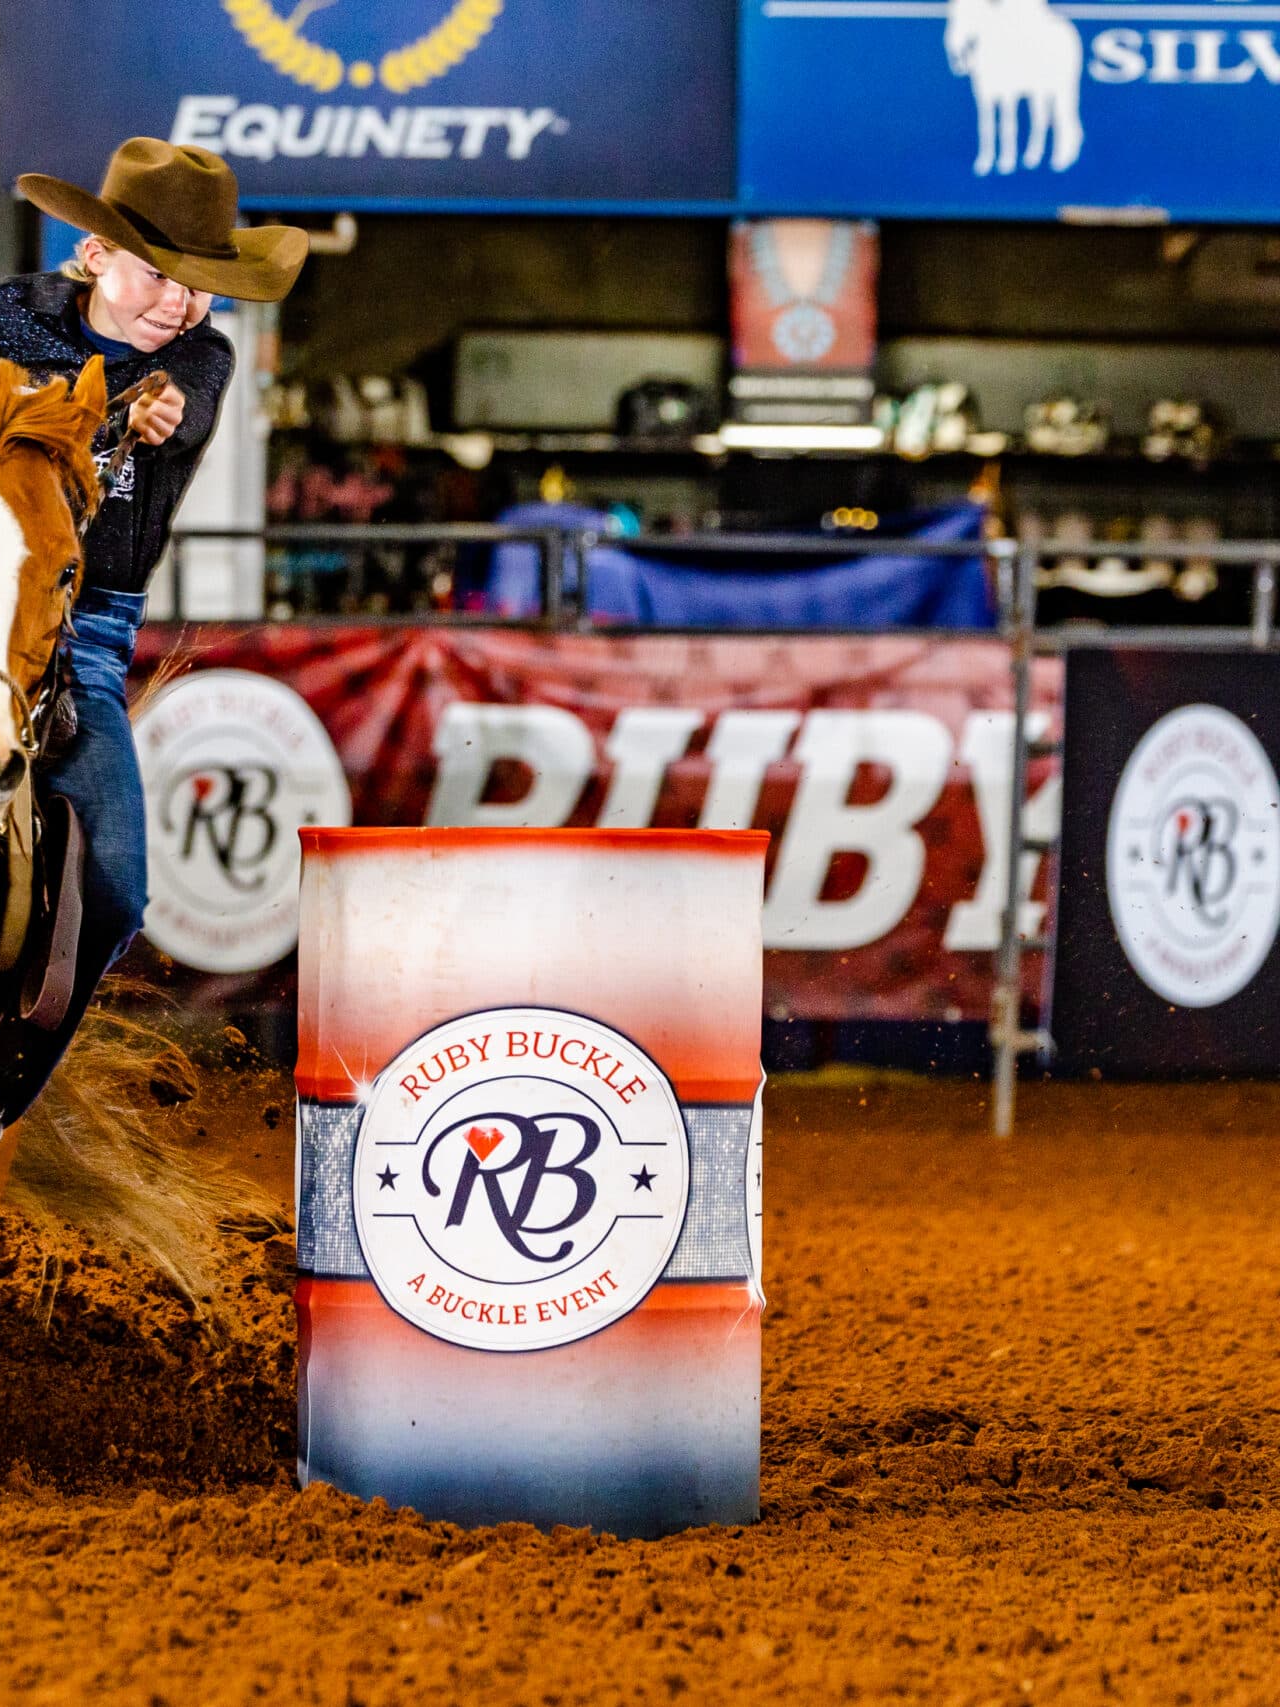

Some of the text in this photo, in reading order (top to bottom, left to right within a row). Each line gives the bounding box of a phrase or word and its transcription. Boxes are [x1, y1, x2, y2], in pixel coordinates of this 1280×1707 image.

[170, 95, 555, 162] EQUINETY
[158, 758, 278, 894] RB
[1153, 797, 1239, 928] RB
[399, 1031, 648, 1105] RUBY BUCKLE
[422, 1112, 601, 1263] RB
[407, 1269, 619, 1325] A BUCKLE EVENT
